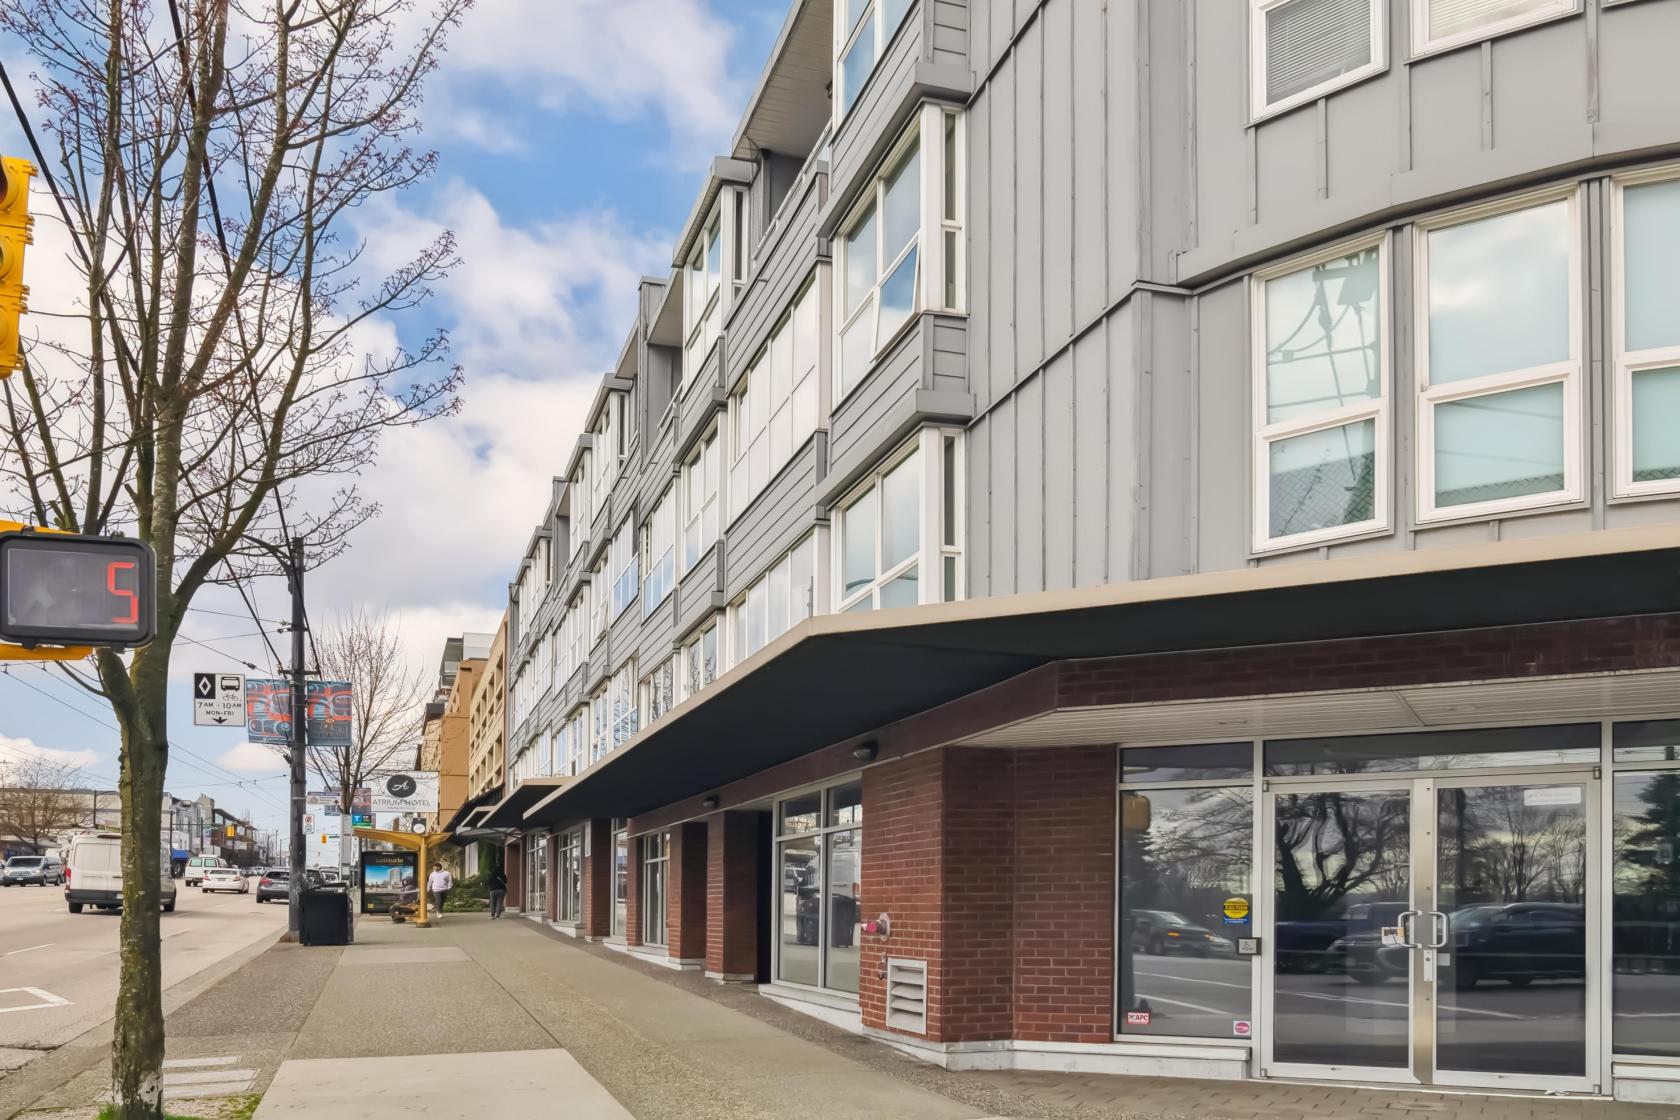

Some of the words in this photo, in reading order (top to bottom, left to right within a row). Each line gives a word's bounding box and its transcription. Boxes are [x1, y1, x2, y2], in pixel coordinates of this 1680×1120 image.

[107, 562, 139, 624] 5
[372, 799, 402, 807] ATRIUM
[404, 799, 431, 807] HOTEL
